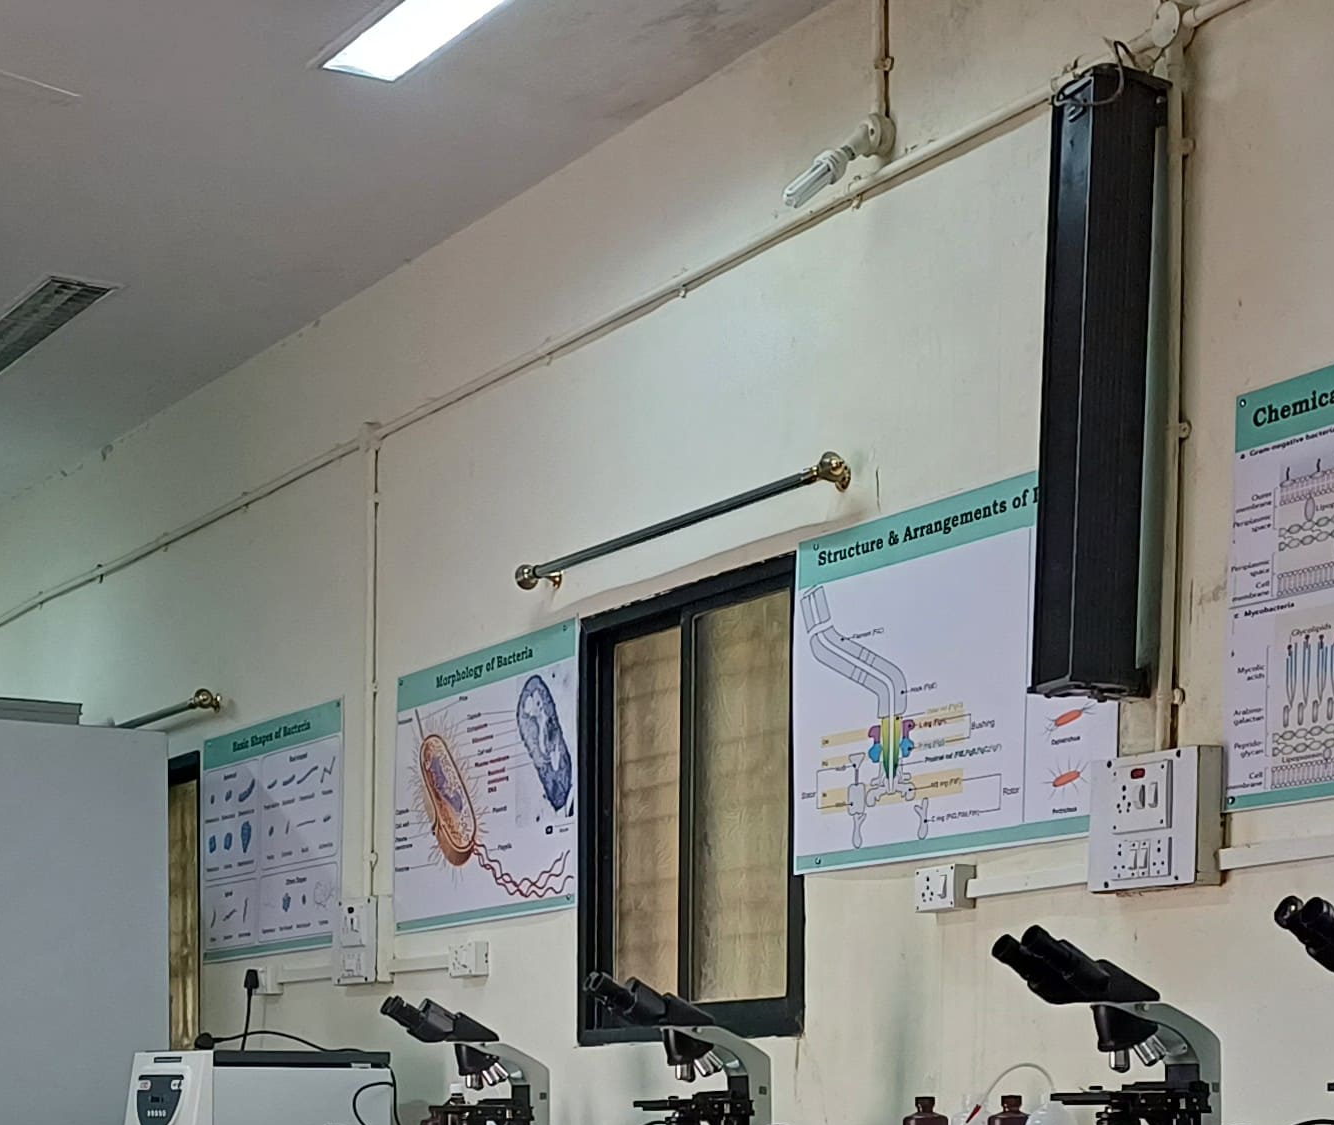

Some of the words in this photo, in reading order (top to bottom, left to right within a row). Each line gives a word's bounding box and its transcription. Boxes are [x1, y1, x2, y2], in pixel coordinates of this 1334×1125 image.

[1249, 436, 1304, 457] Gram-negative
[817, 536, 884, 567] Structure
[888, 530, 899, 547] &
[902, 498, 1007, 544] Arrangements
[1011, 489, 1029, 509] of
[1243, 601, 1295, 619] Mycobacteria
[1291, 622, 1332, 638] Glycolipids
[435, 661, 483, 689] Morphology
[485, 656, 496, 673] of
[497, 646, 534, 669] Bacteria
[232, 739, 249, 753] Basic
[250, 732, 273, 747] Shapes
[274, 726, 282, 740] of
[282, 720, 311, 737] Bacteria
